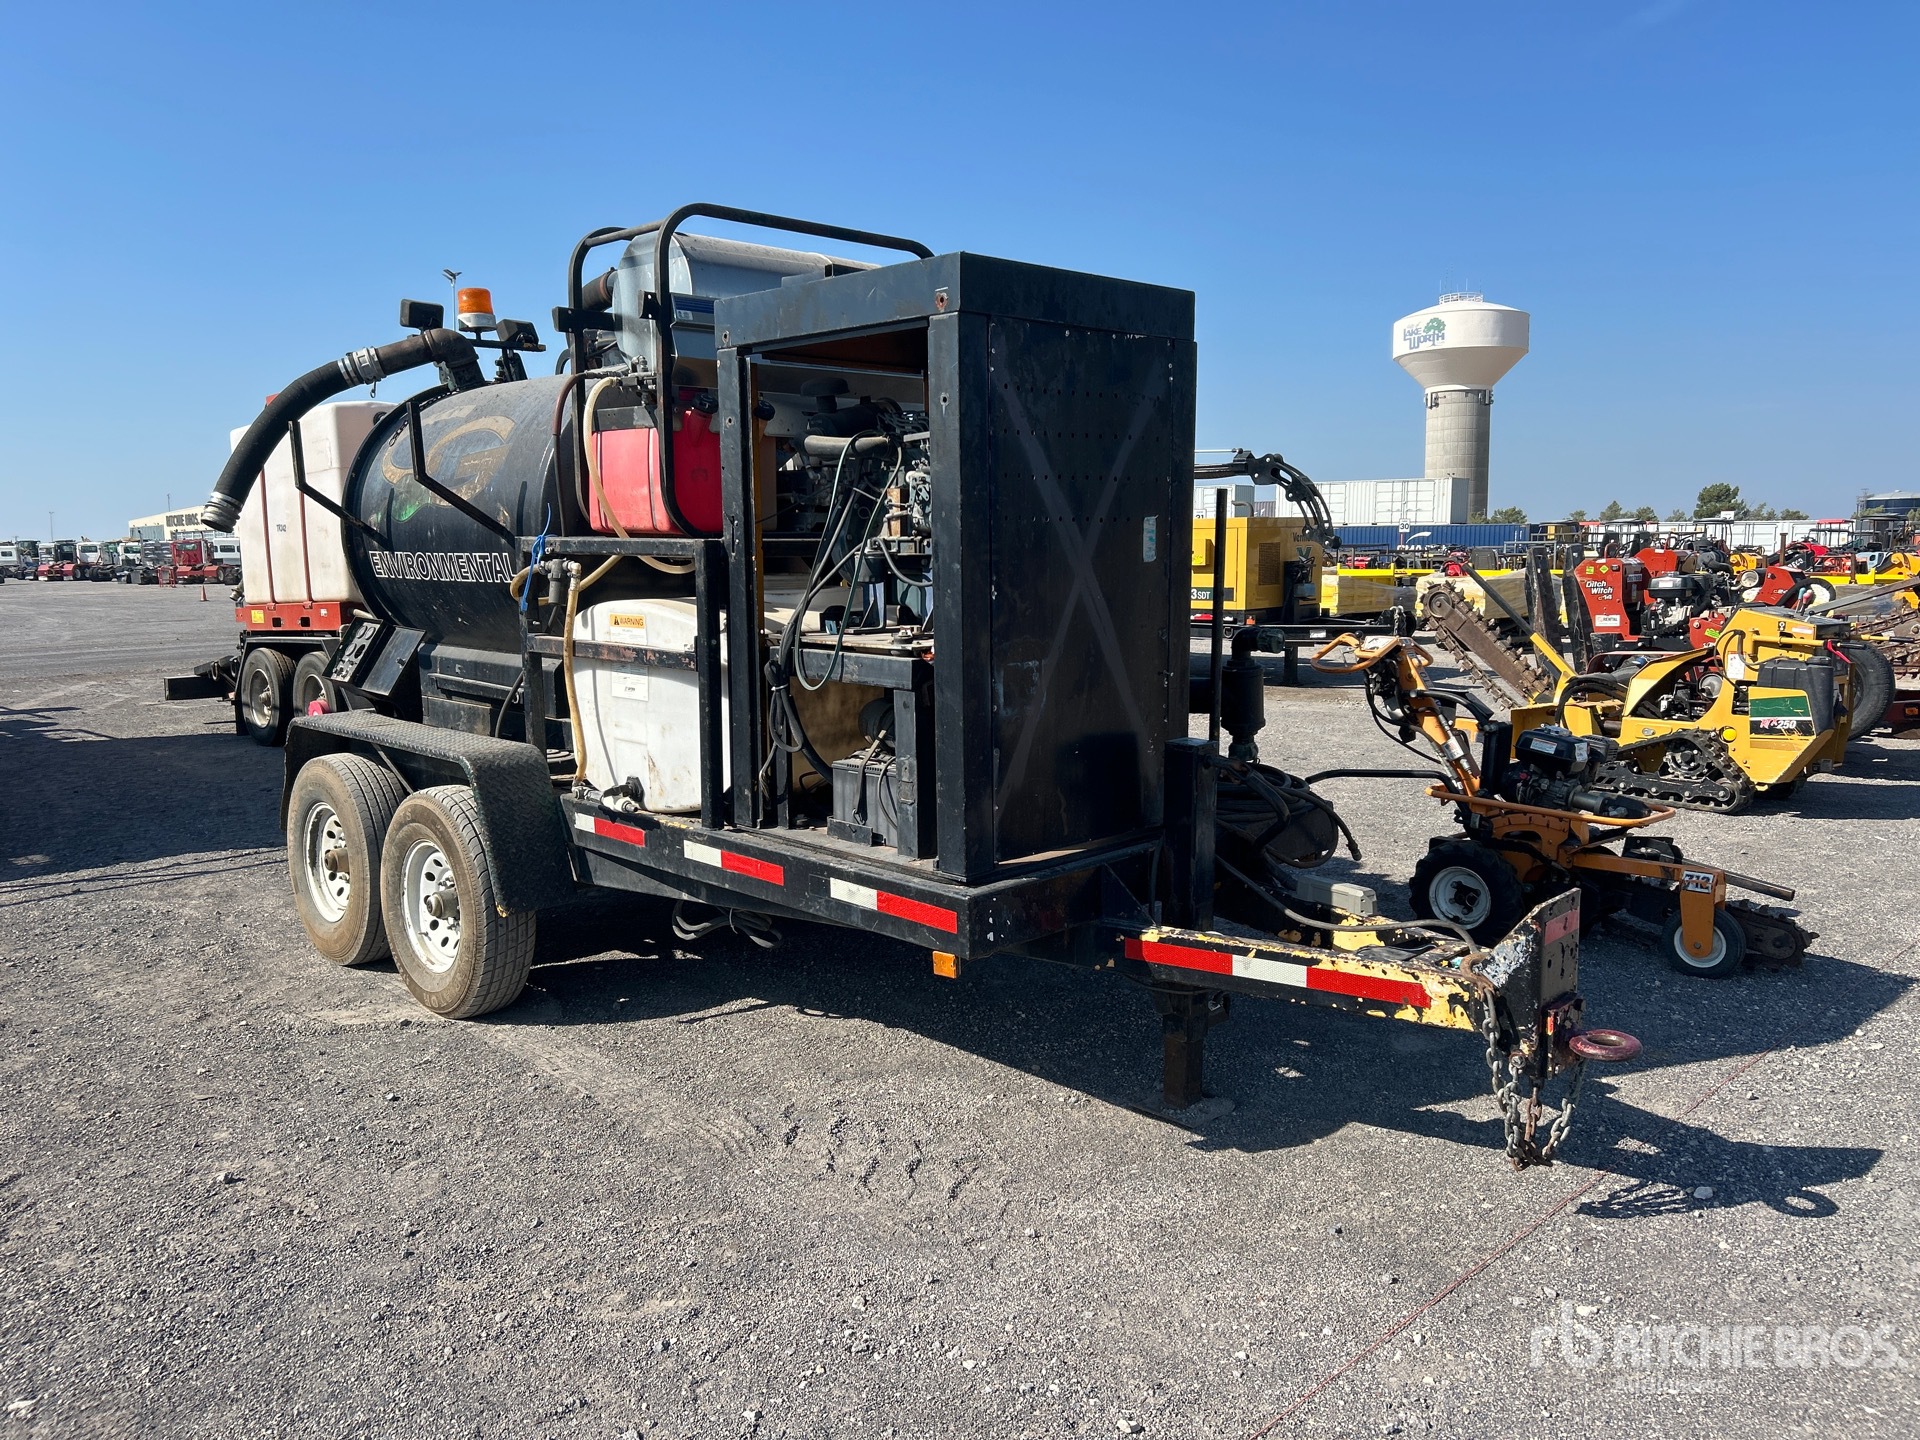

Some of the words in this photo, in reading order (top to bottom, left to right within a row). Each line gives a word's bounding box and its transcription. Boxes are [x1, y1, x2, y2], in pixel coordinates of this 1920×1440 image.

[1403, 328, 1422, 341] LAKE
[1409, 333, 1445, 350] WORTH
[1400, 522, 1409, 530] 30
[369, 551, 517, 583] ENVIRONMENTAL
[1586, 580, 1607, 588] Ditch
[1591, 587, 1613, 595] Witch
[619, 617, 644, 626] WARNING
